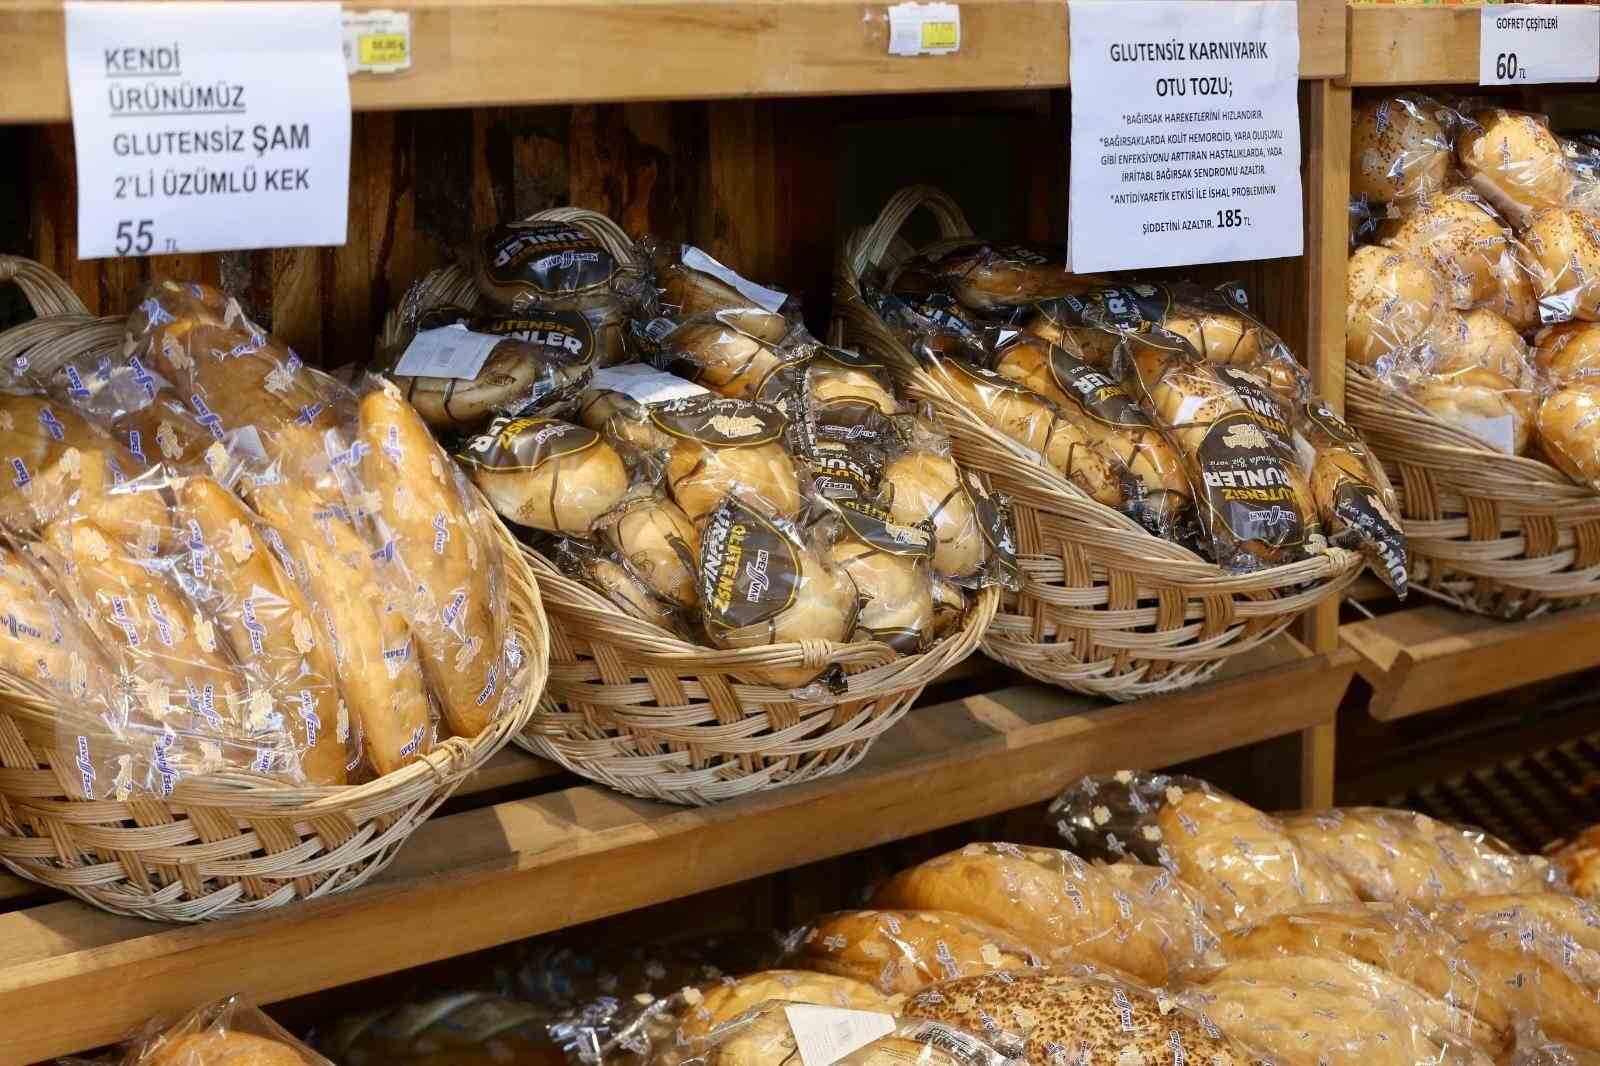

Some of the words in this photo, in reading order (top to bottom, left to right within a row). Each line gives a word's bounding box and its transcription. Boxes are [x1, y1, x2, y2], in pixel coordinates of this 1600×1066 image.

[1496, 17, 1525, 30] GOFRET
[1526, 15, 1558, 32] ÇEŞİTLERİ
[104, 41, 181, 72] KENDİ
[1110, 38, 1186, 62] GLUTENSİZ
[1189, 41, 1269, 61] KARNIYARIK
[1496, 53, 1517, 79] 60
[1518, 68, 1526, 79] TL
[108, 81, 246, 112] ÜRÜNÜMÜZ
[1156, 78, 1186, 97] OTU
[1189, 77, 1233, 98] TOZU;
[1164, 109, 1221, 123] HAREKETLERİNİ
[112, 124, 245, 157] GLUTENSİZ
[252, 124, 310, 157] ŞAM
[1167, 131, 1187, 144] KOLİT
[1234, 130, 1251, 141] YARA
[1101, 153, 1117, 166] GİBİ
[1118, 152, 1170, 165] ENFEKSİYONU
[1171, 151, 1208, 162] ARTTIRAN
[114, 173, 155, 200] 2'Lİ
[162, 165, 256, 198] ÜZÜMLÜ
[265, 168, 310, 192] KEK
[1156, 168, 1192, 180] BAĞIRSAK
[1194, 167, 1238, 178] SENDROMU
[1171, 188, 1195, 201] ETKİSİ
[1195, 187, 1207, 199] İLE
[1208, 186, 1230, 198] İSHAL
[1142, 219, 1180, 236] ŞİDDETİNİ
[1216, 209, 1242, 228] 185
[1243, 216, 1252, 226] TL
[115, 219, 154, 257] 55
[165, 238, 178, 251] TL
[130, 431, 142, 453] KEPEZ
[12, 458, 29, 481] KEPEZ
[825, 482, 853, 490] KEPEZ
[307, 721, 316, 746] KEPEZ
